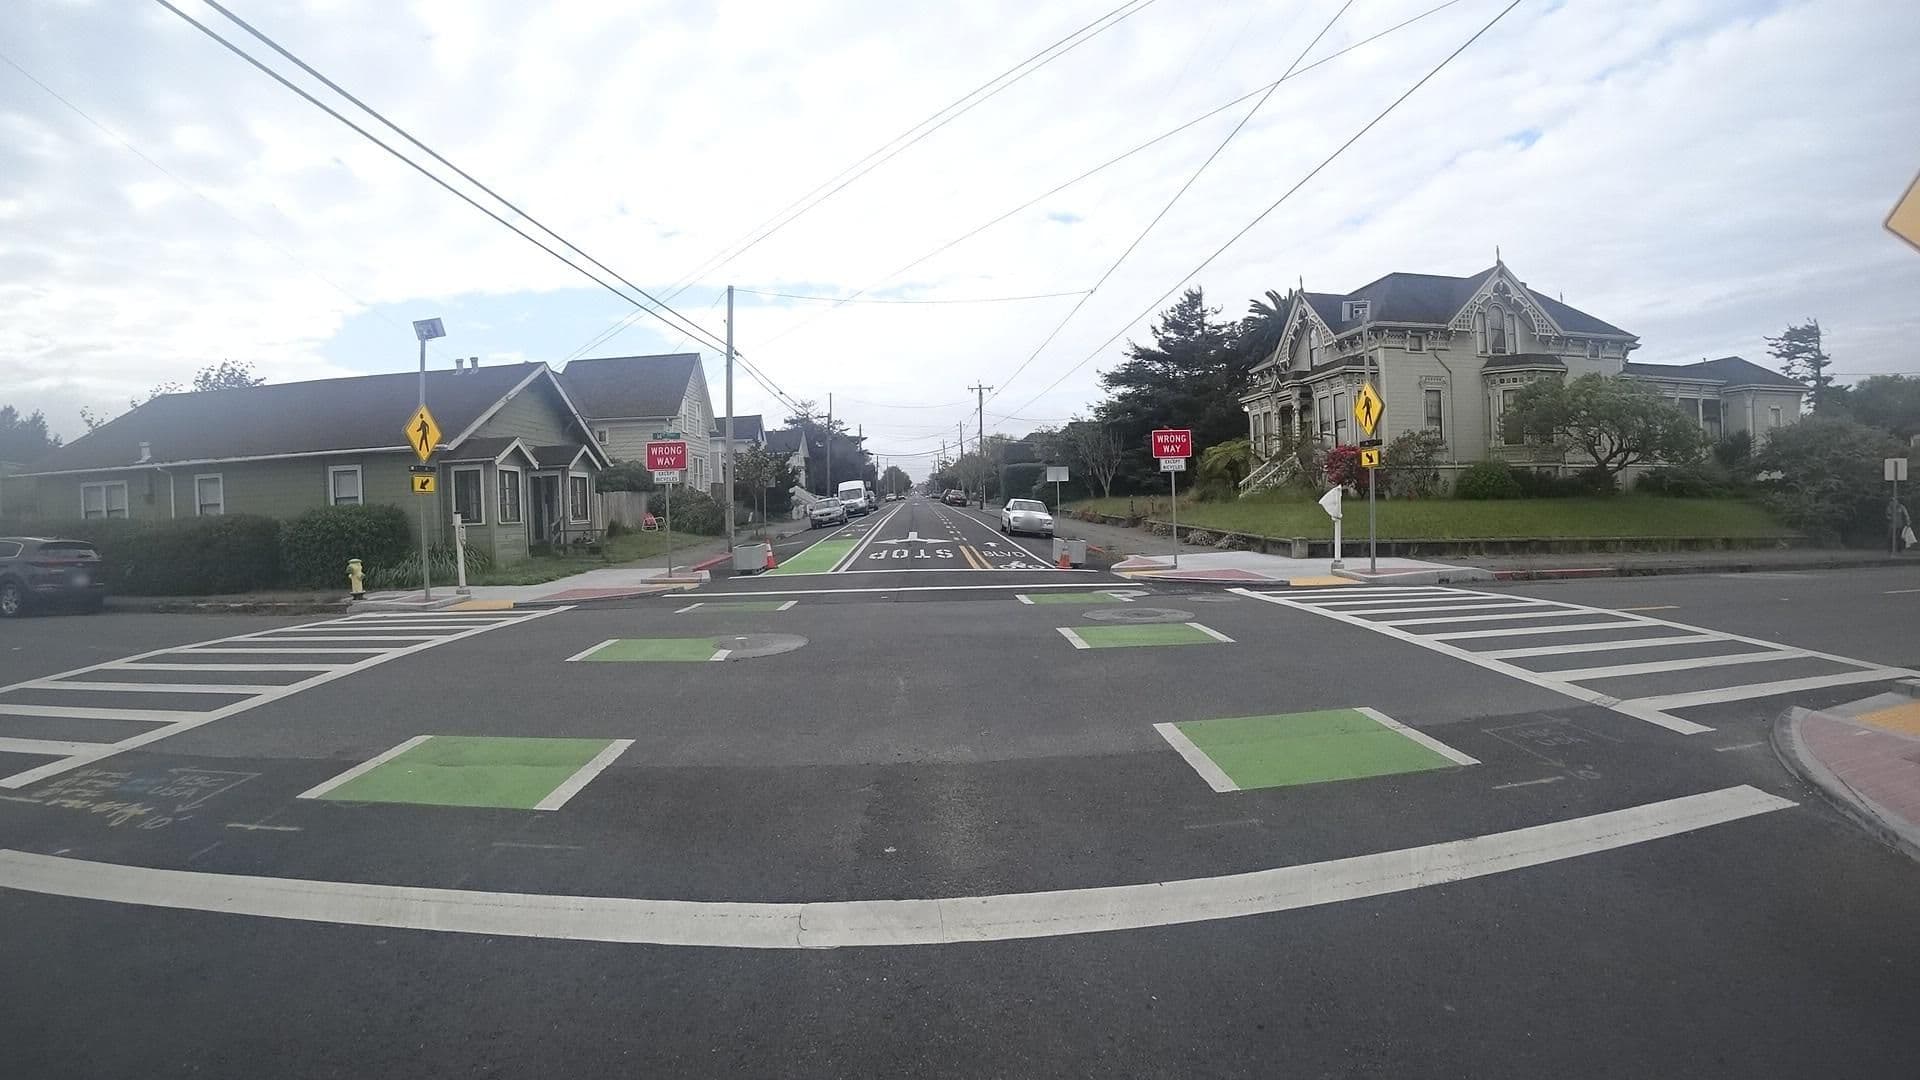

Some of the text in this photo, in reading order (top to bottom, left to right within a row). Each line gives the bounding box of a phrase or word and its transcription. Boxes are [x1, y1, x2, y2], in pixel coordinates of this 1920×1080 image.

[1157, 434, 1187, 443] WRONG
[651, 446, 682, 455] WRONG
[1162, 444, 1181, 453] WAY
[656, 457, 676, 466] WAY
[869, 549, 954, 560] STOP
[983, 550, 1026, 558] BLVD
